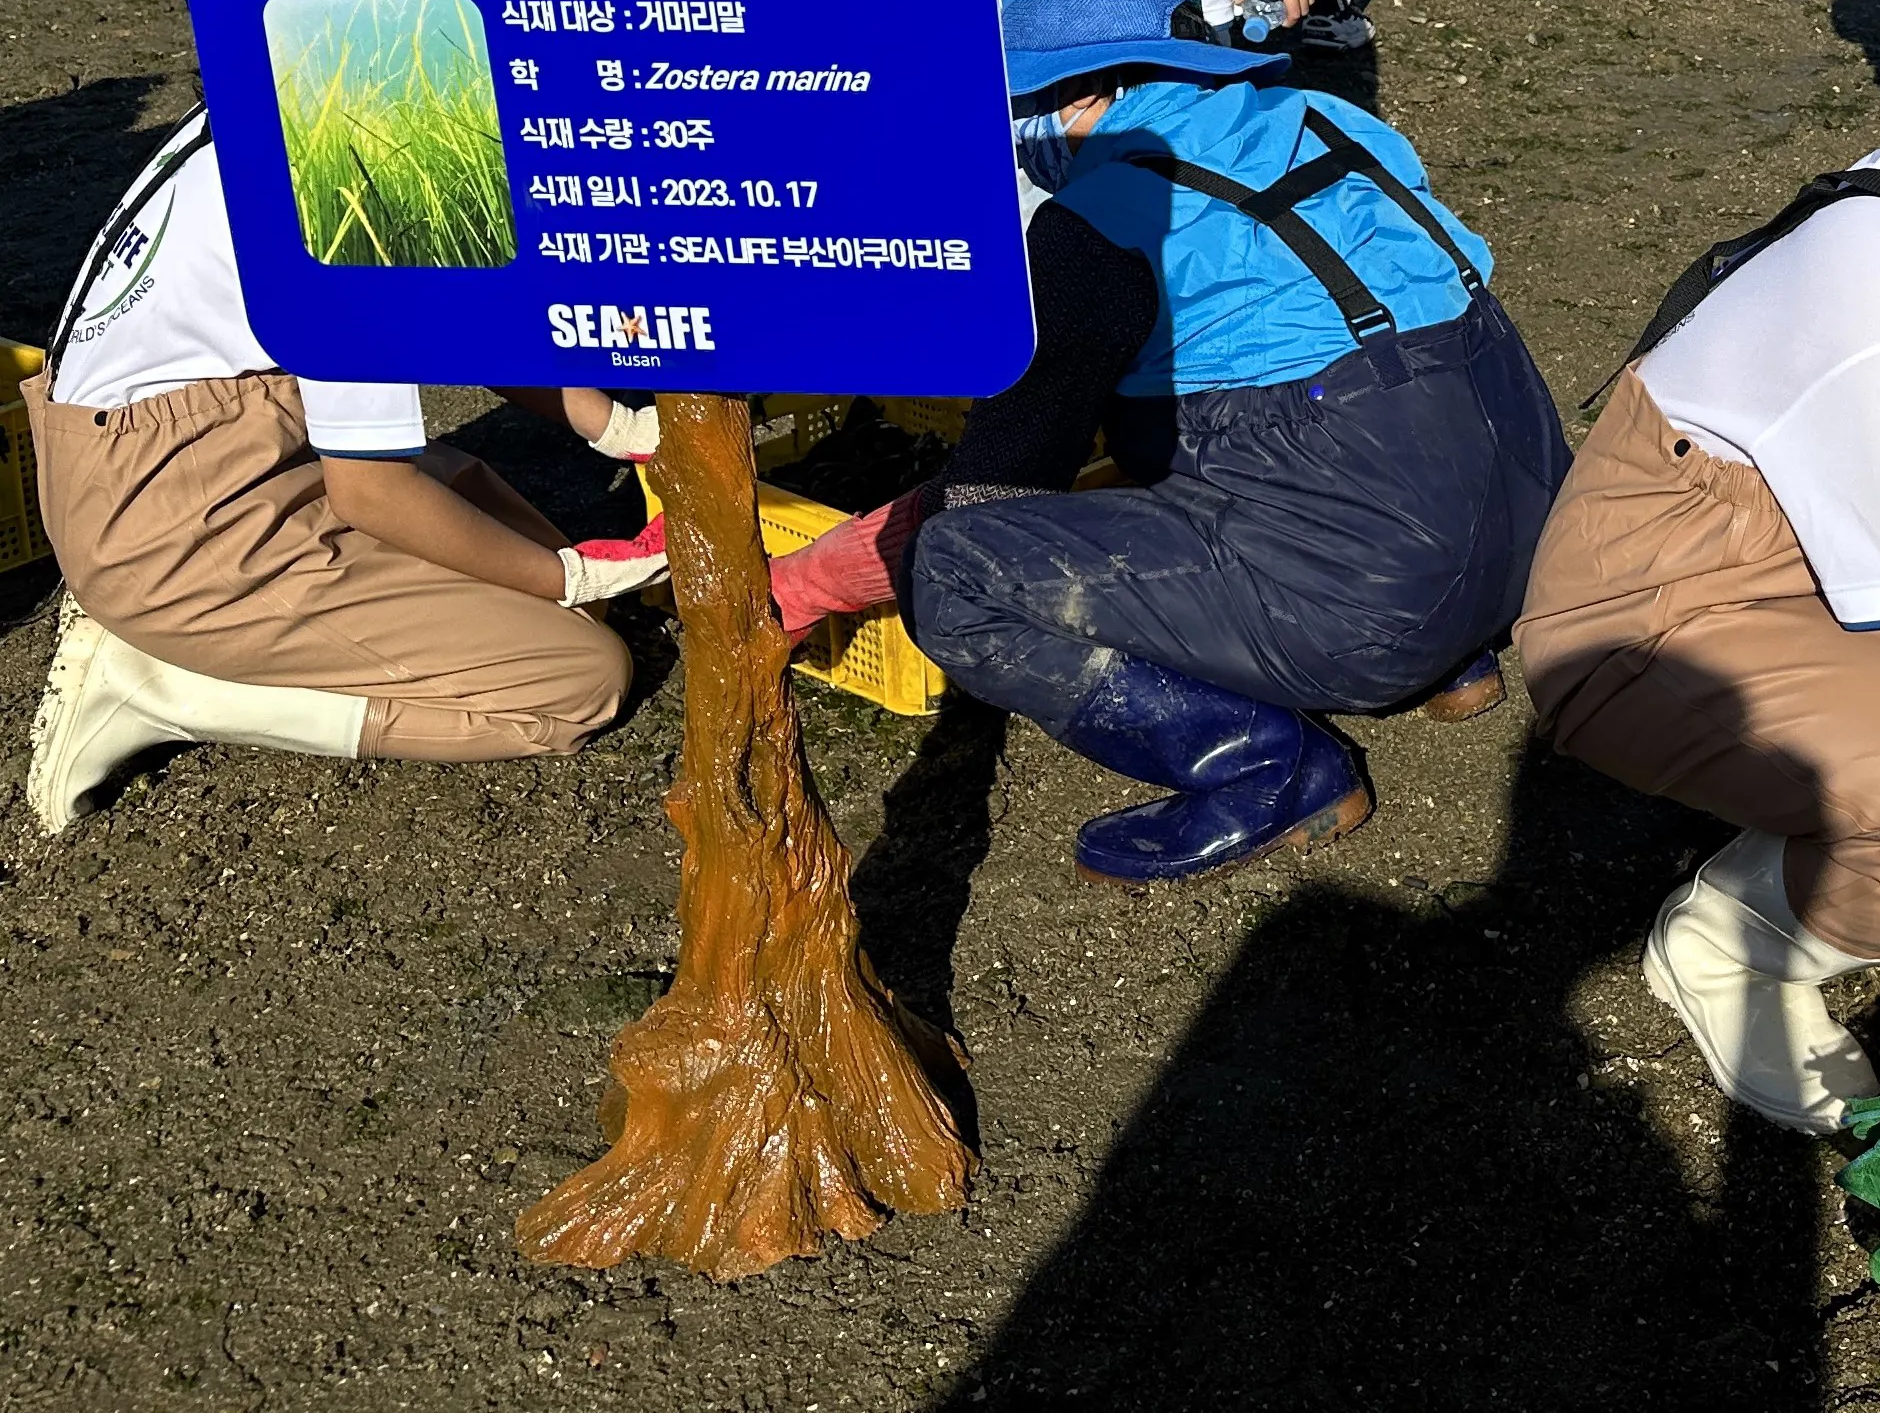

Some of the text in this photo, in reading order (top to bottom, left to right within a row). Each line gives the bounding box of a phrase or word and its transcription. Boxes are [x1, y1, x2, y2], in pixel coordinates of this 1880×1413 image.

[502, 0, 557, 33] 식재
[560, 0, 616, 33] 대상
[509, 58, 540, 92] 학
[596, 59, 625, 92] 명
[645, 62, 760, 91] Zostera
[766, 64, 871, 92] marina
[520, 117, 575, 150] 식재
[578, 117, 634, 150] 수량
[529, 175, 582, 207] 식재
[586, 176, 642, 207] 일시
[785, 181, 818, 208] 17
[538, 232, 592, 264] 식재
[595, 233, 651, 265] 기관
[782, 237, 972, 271] 부산아쿠아리움
[611, 351, 661, 368] Busan
